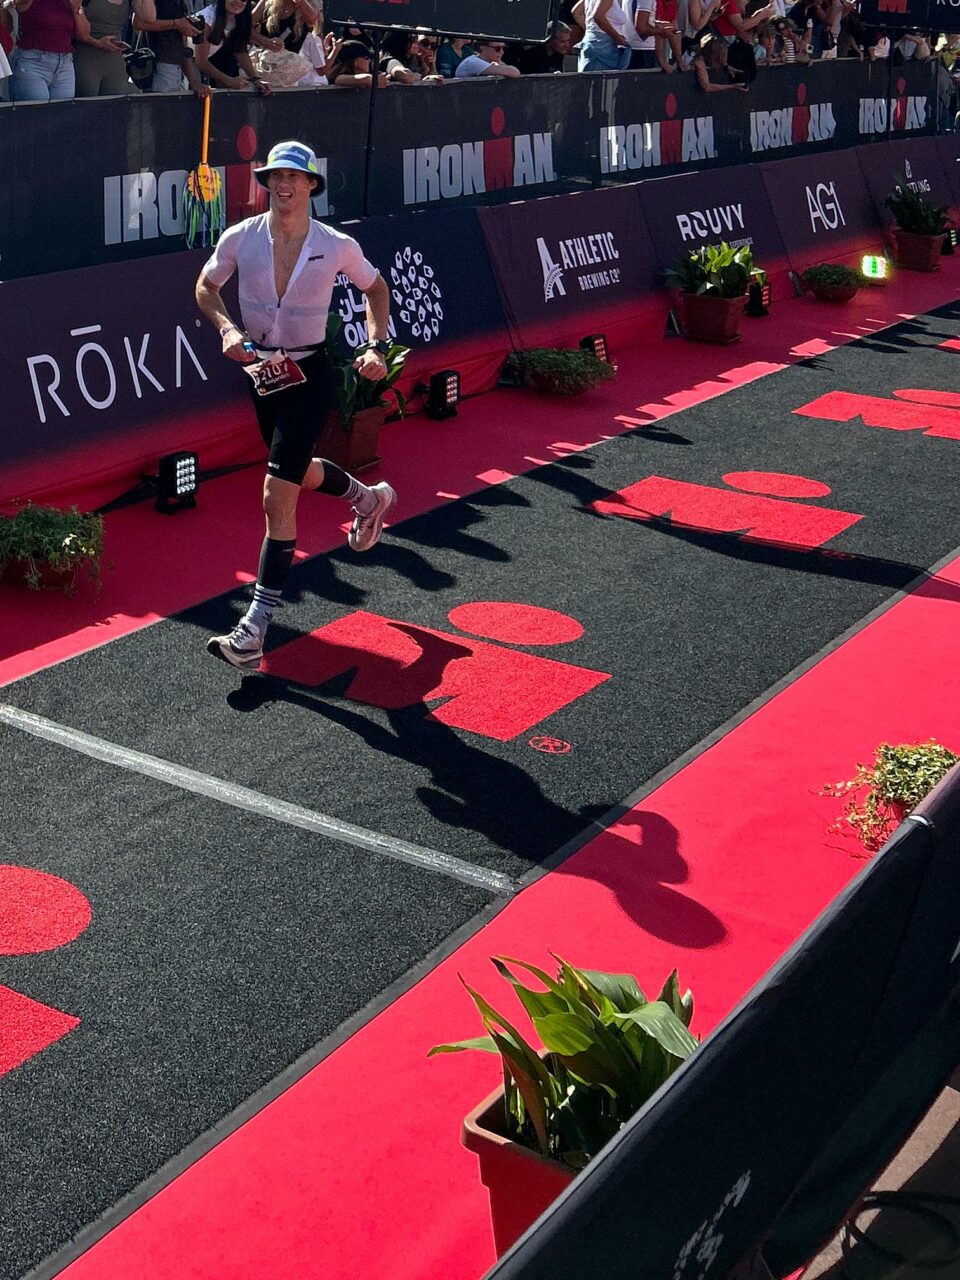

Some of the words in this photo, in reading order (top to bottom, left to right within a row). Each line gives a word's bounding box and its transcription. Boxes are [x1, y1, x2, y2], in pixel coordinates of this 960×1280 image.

[600, 93, 716, 174] IRONMAN
[749, 83, 837, 152] IRONMAN
[403, 106, 553, 205] IRONMAN
[676, 204, 744, 241] ROUVY
[559, 231, 619, 270] ATHLETIC
[578, 271, 610, 291] BREWING
